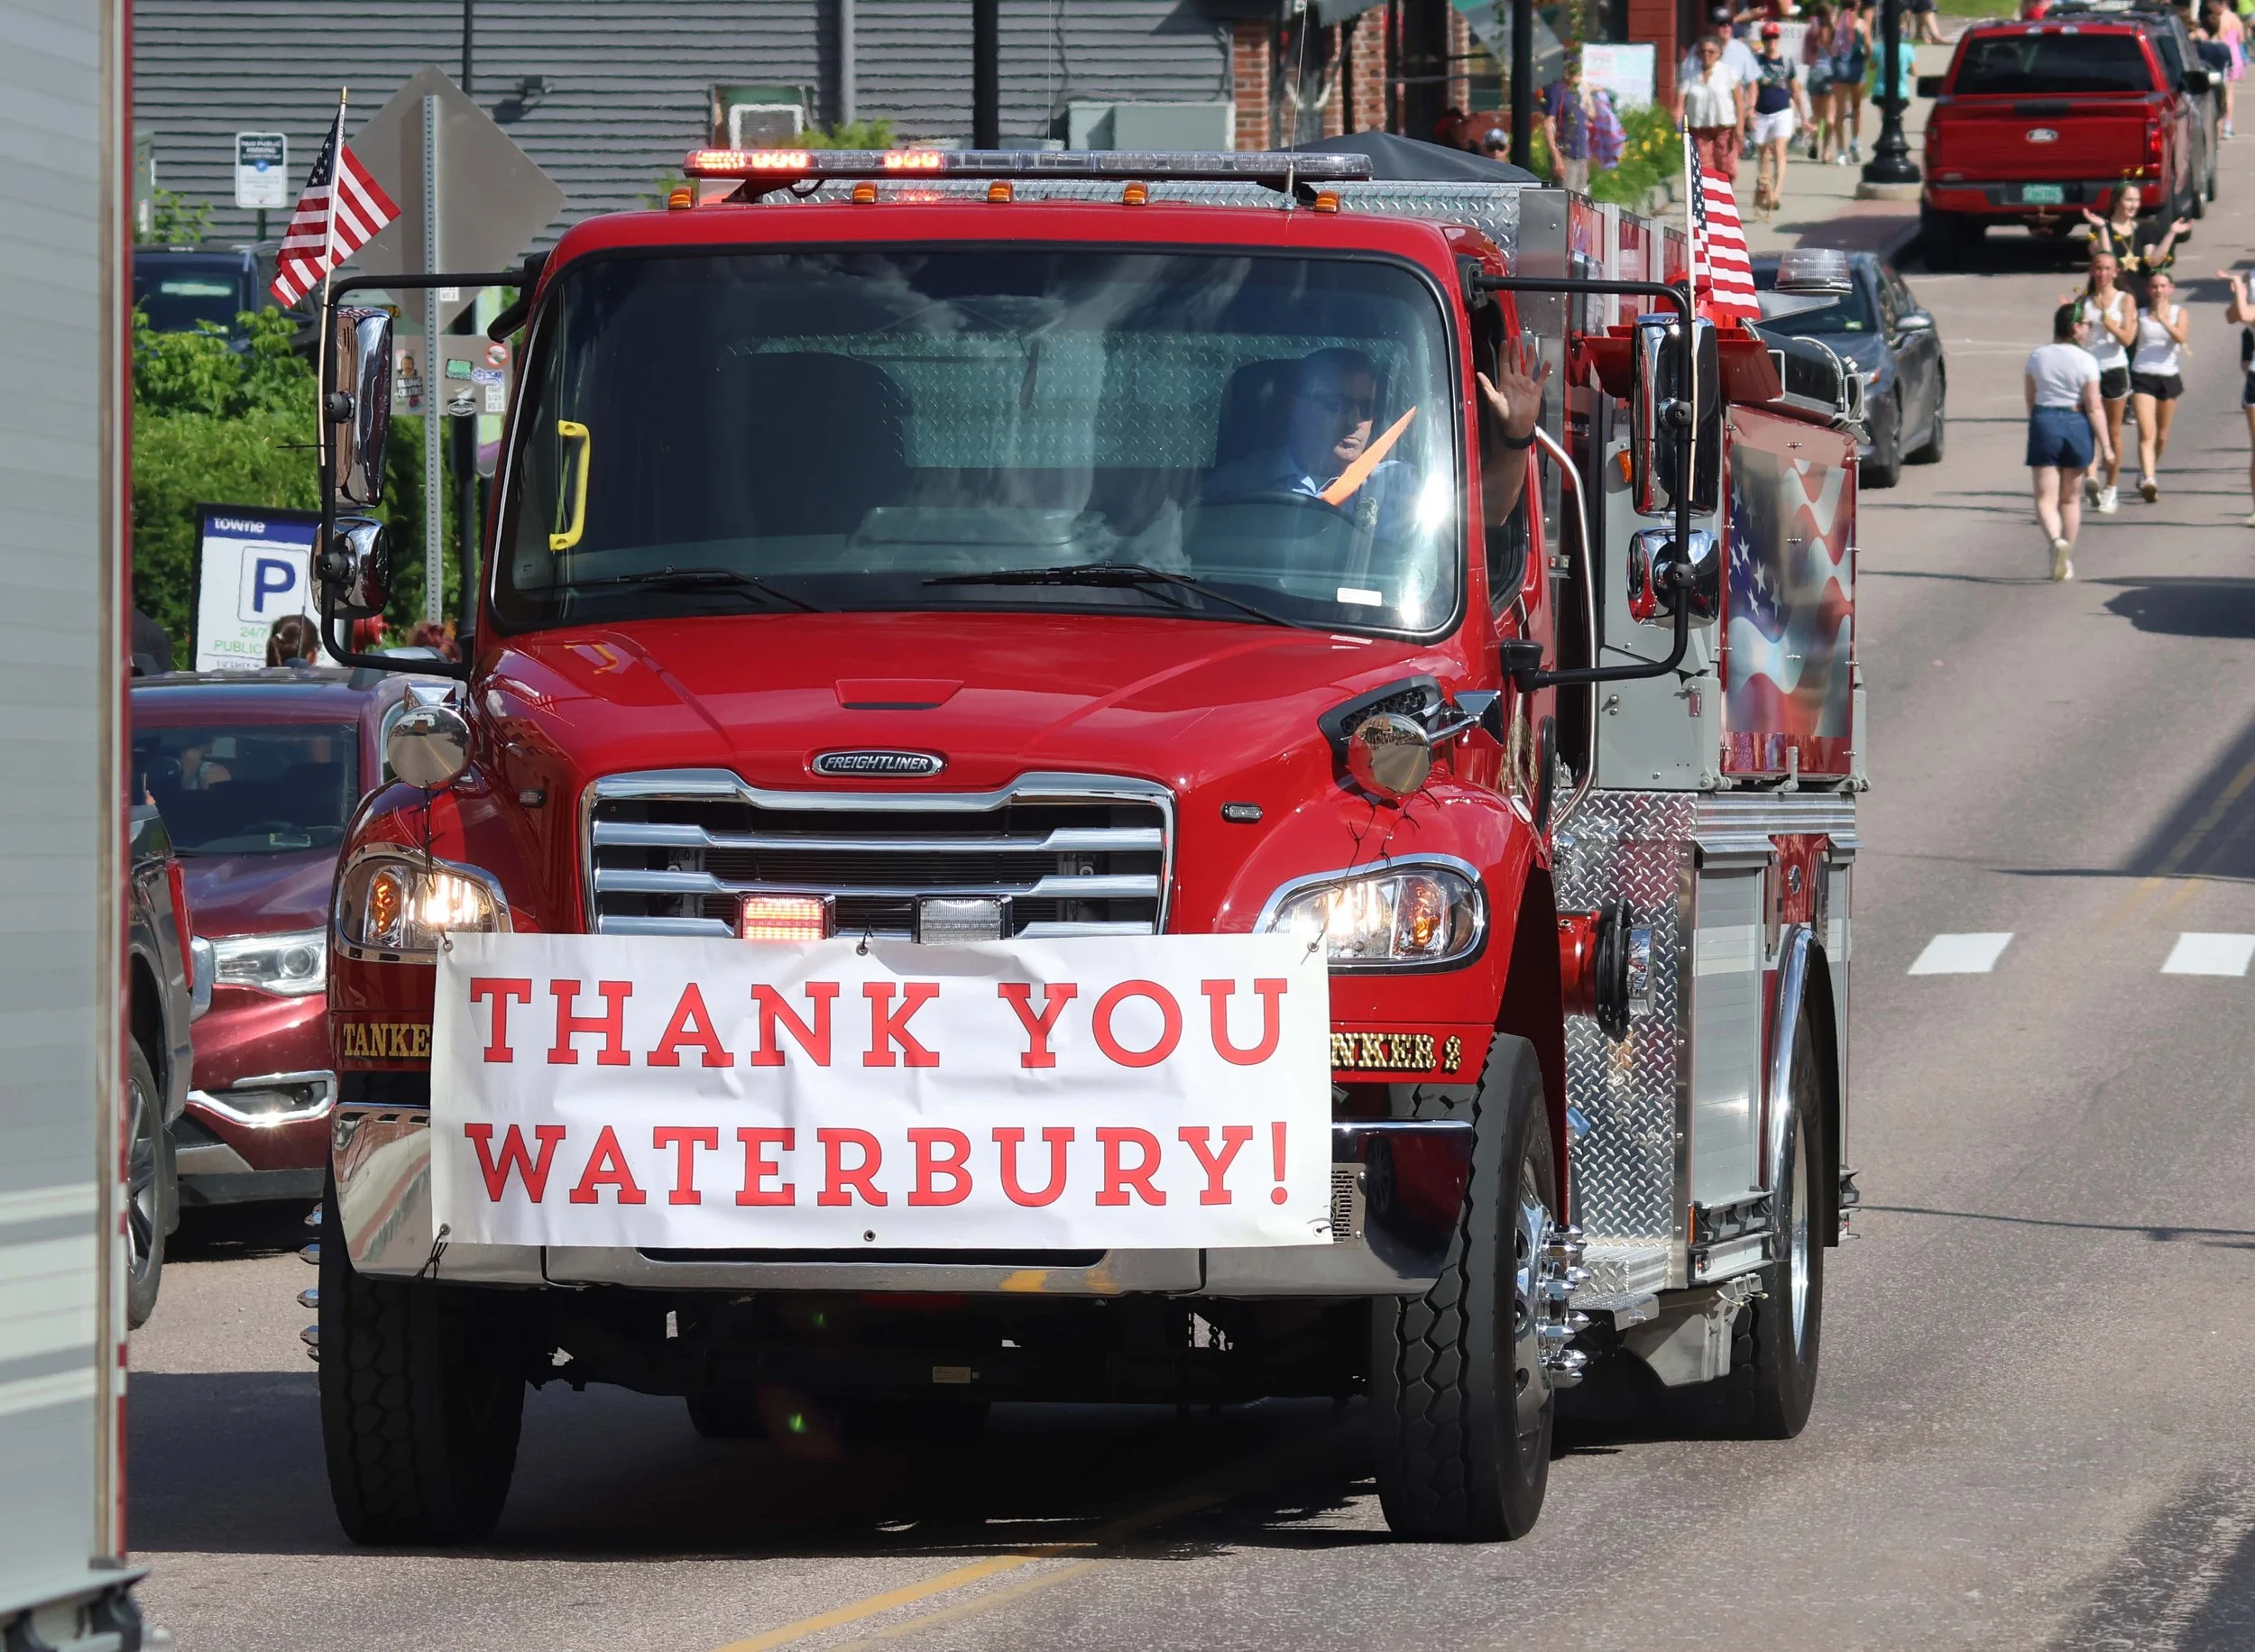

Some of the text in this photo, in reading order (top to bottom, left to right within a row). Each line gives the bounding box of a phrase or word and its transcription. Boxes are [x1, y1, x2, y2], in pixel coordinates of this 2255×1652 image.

[213, 518, 266, 534] towne
[253, 557, 296, 613] P
[213, 639, 263, 655] PUBLIC
[240, 626, 267, 638] 24/7
[824, 756, 929, 770] FREIGHTLINER
[343, 1023, 431, 1057] TANKE
[469, 977, 1288, 1069] THANK YOU
[1330, 1032, 1437, 1069] NKER
[465, 1121, 1288, 1207] WATERBURY!
